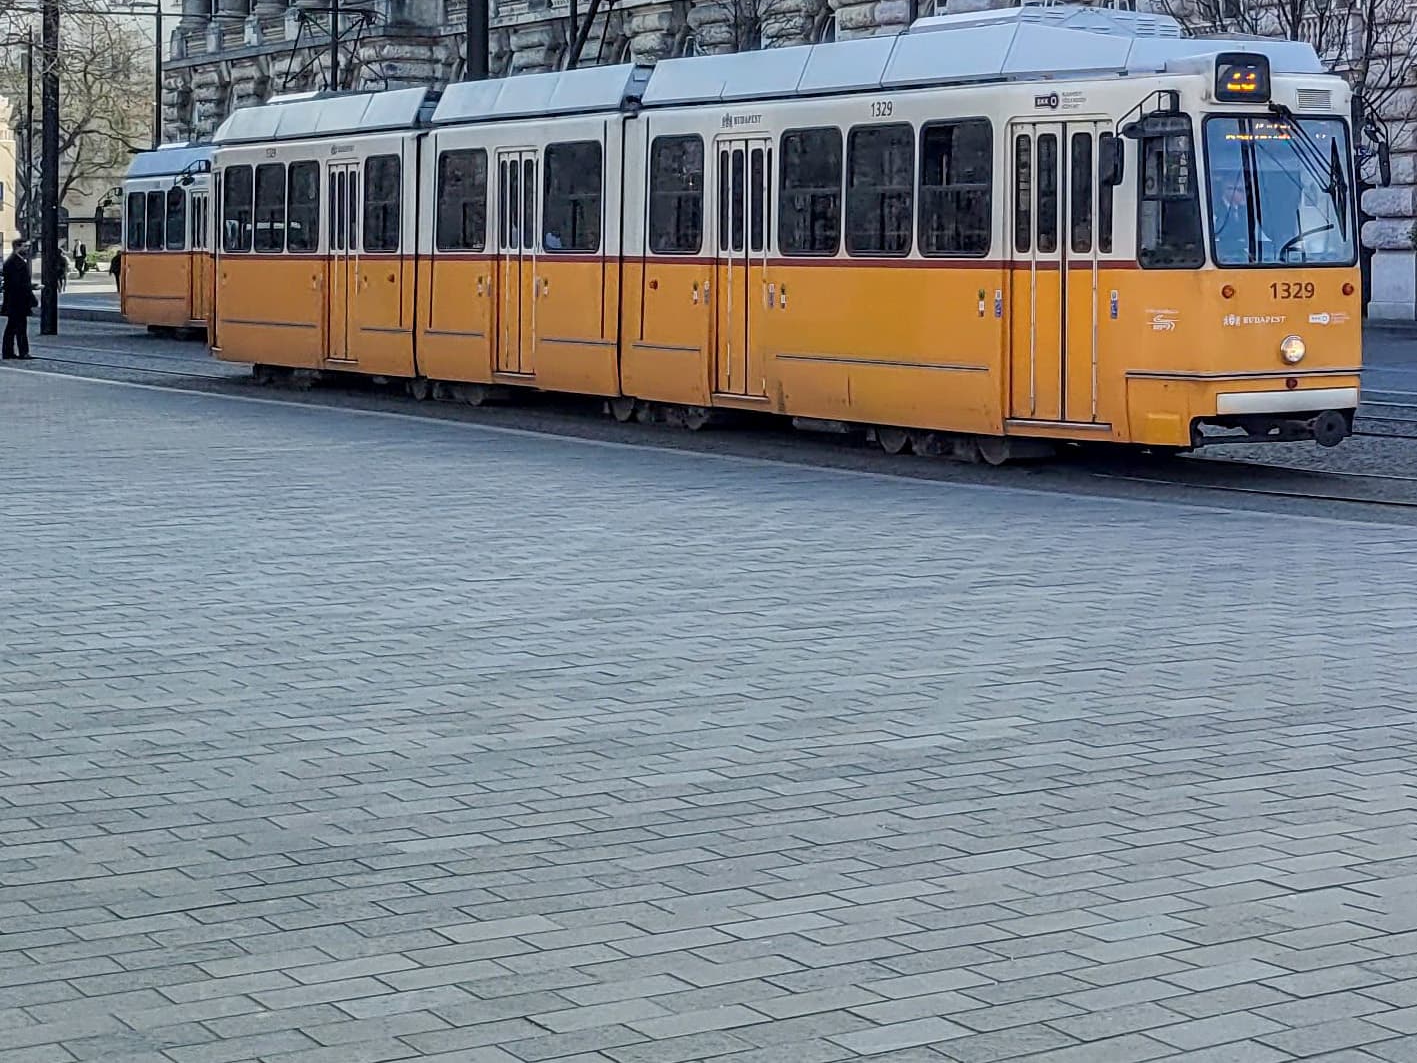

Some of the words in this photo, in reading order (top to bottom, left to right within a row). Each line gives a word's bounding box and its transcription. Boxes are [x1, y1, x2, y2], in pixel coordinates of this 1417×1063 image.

[870, 101, 893, 117] 1329
[1269, 282, 1315, 299] 1329
[1243, 315, 1287, 324] BUDAPEST
